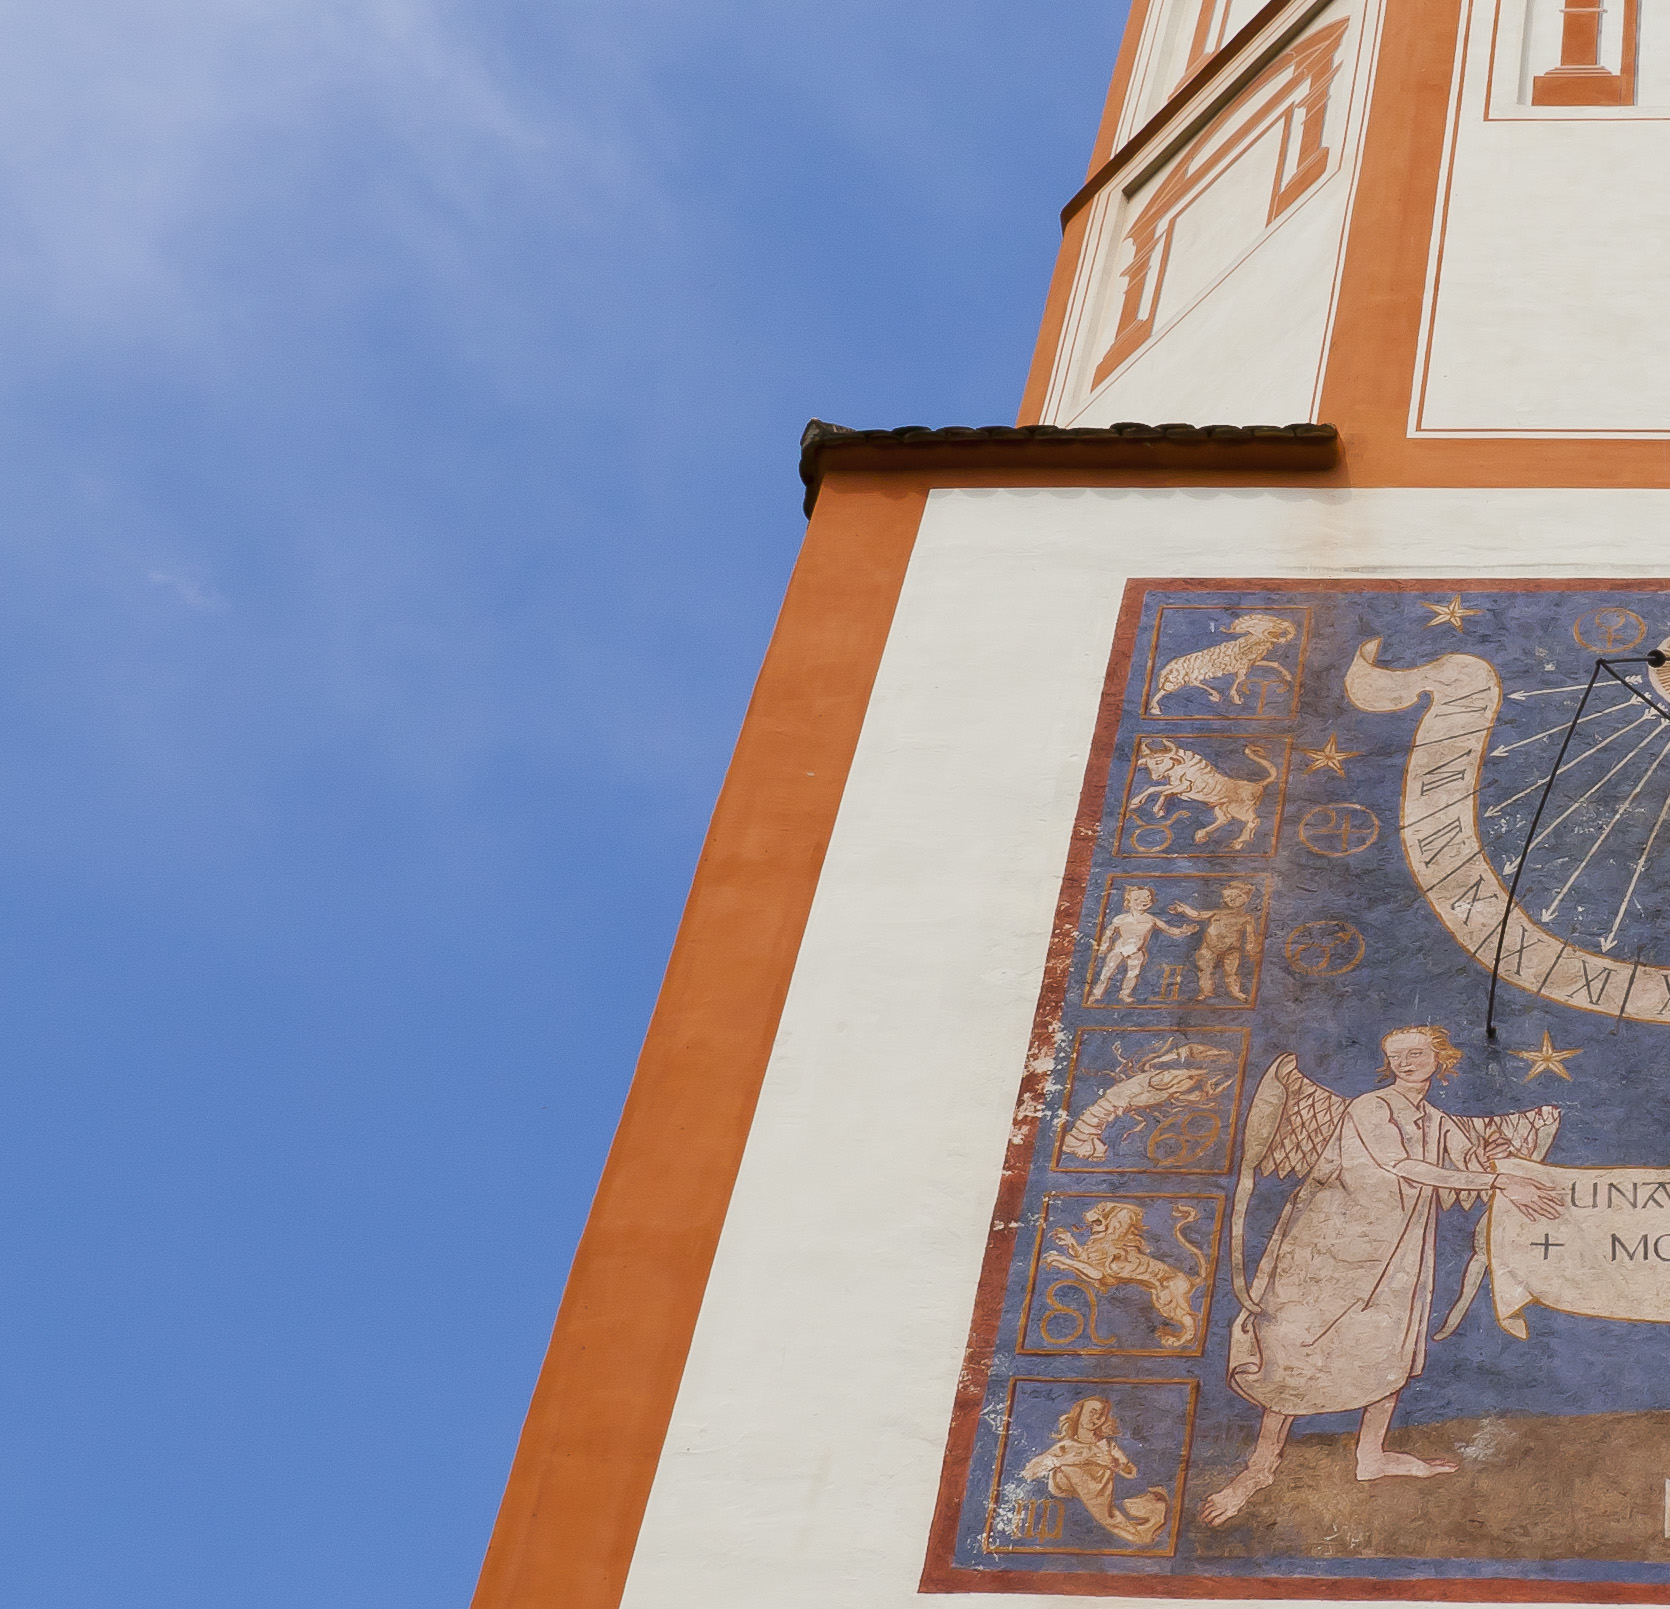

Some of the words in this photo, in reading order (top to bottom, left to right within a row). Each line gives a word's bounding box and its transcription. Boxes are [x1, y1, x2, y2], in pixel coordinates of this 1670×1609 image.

[1434, 686, 1491, 718] VI
[1420, 748, 1473, 796] VII
[1451, 874, 1498, 926] IX
[1493, 924, 1546, 977] X
[1566, 959, 1617, 1005] XI
